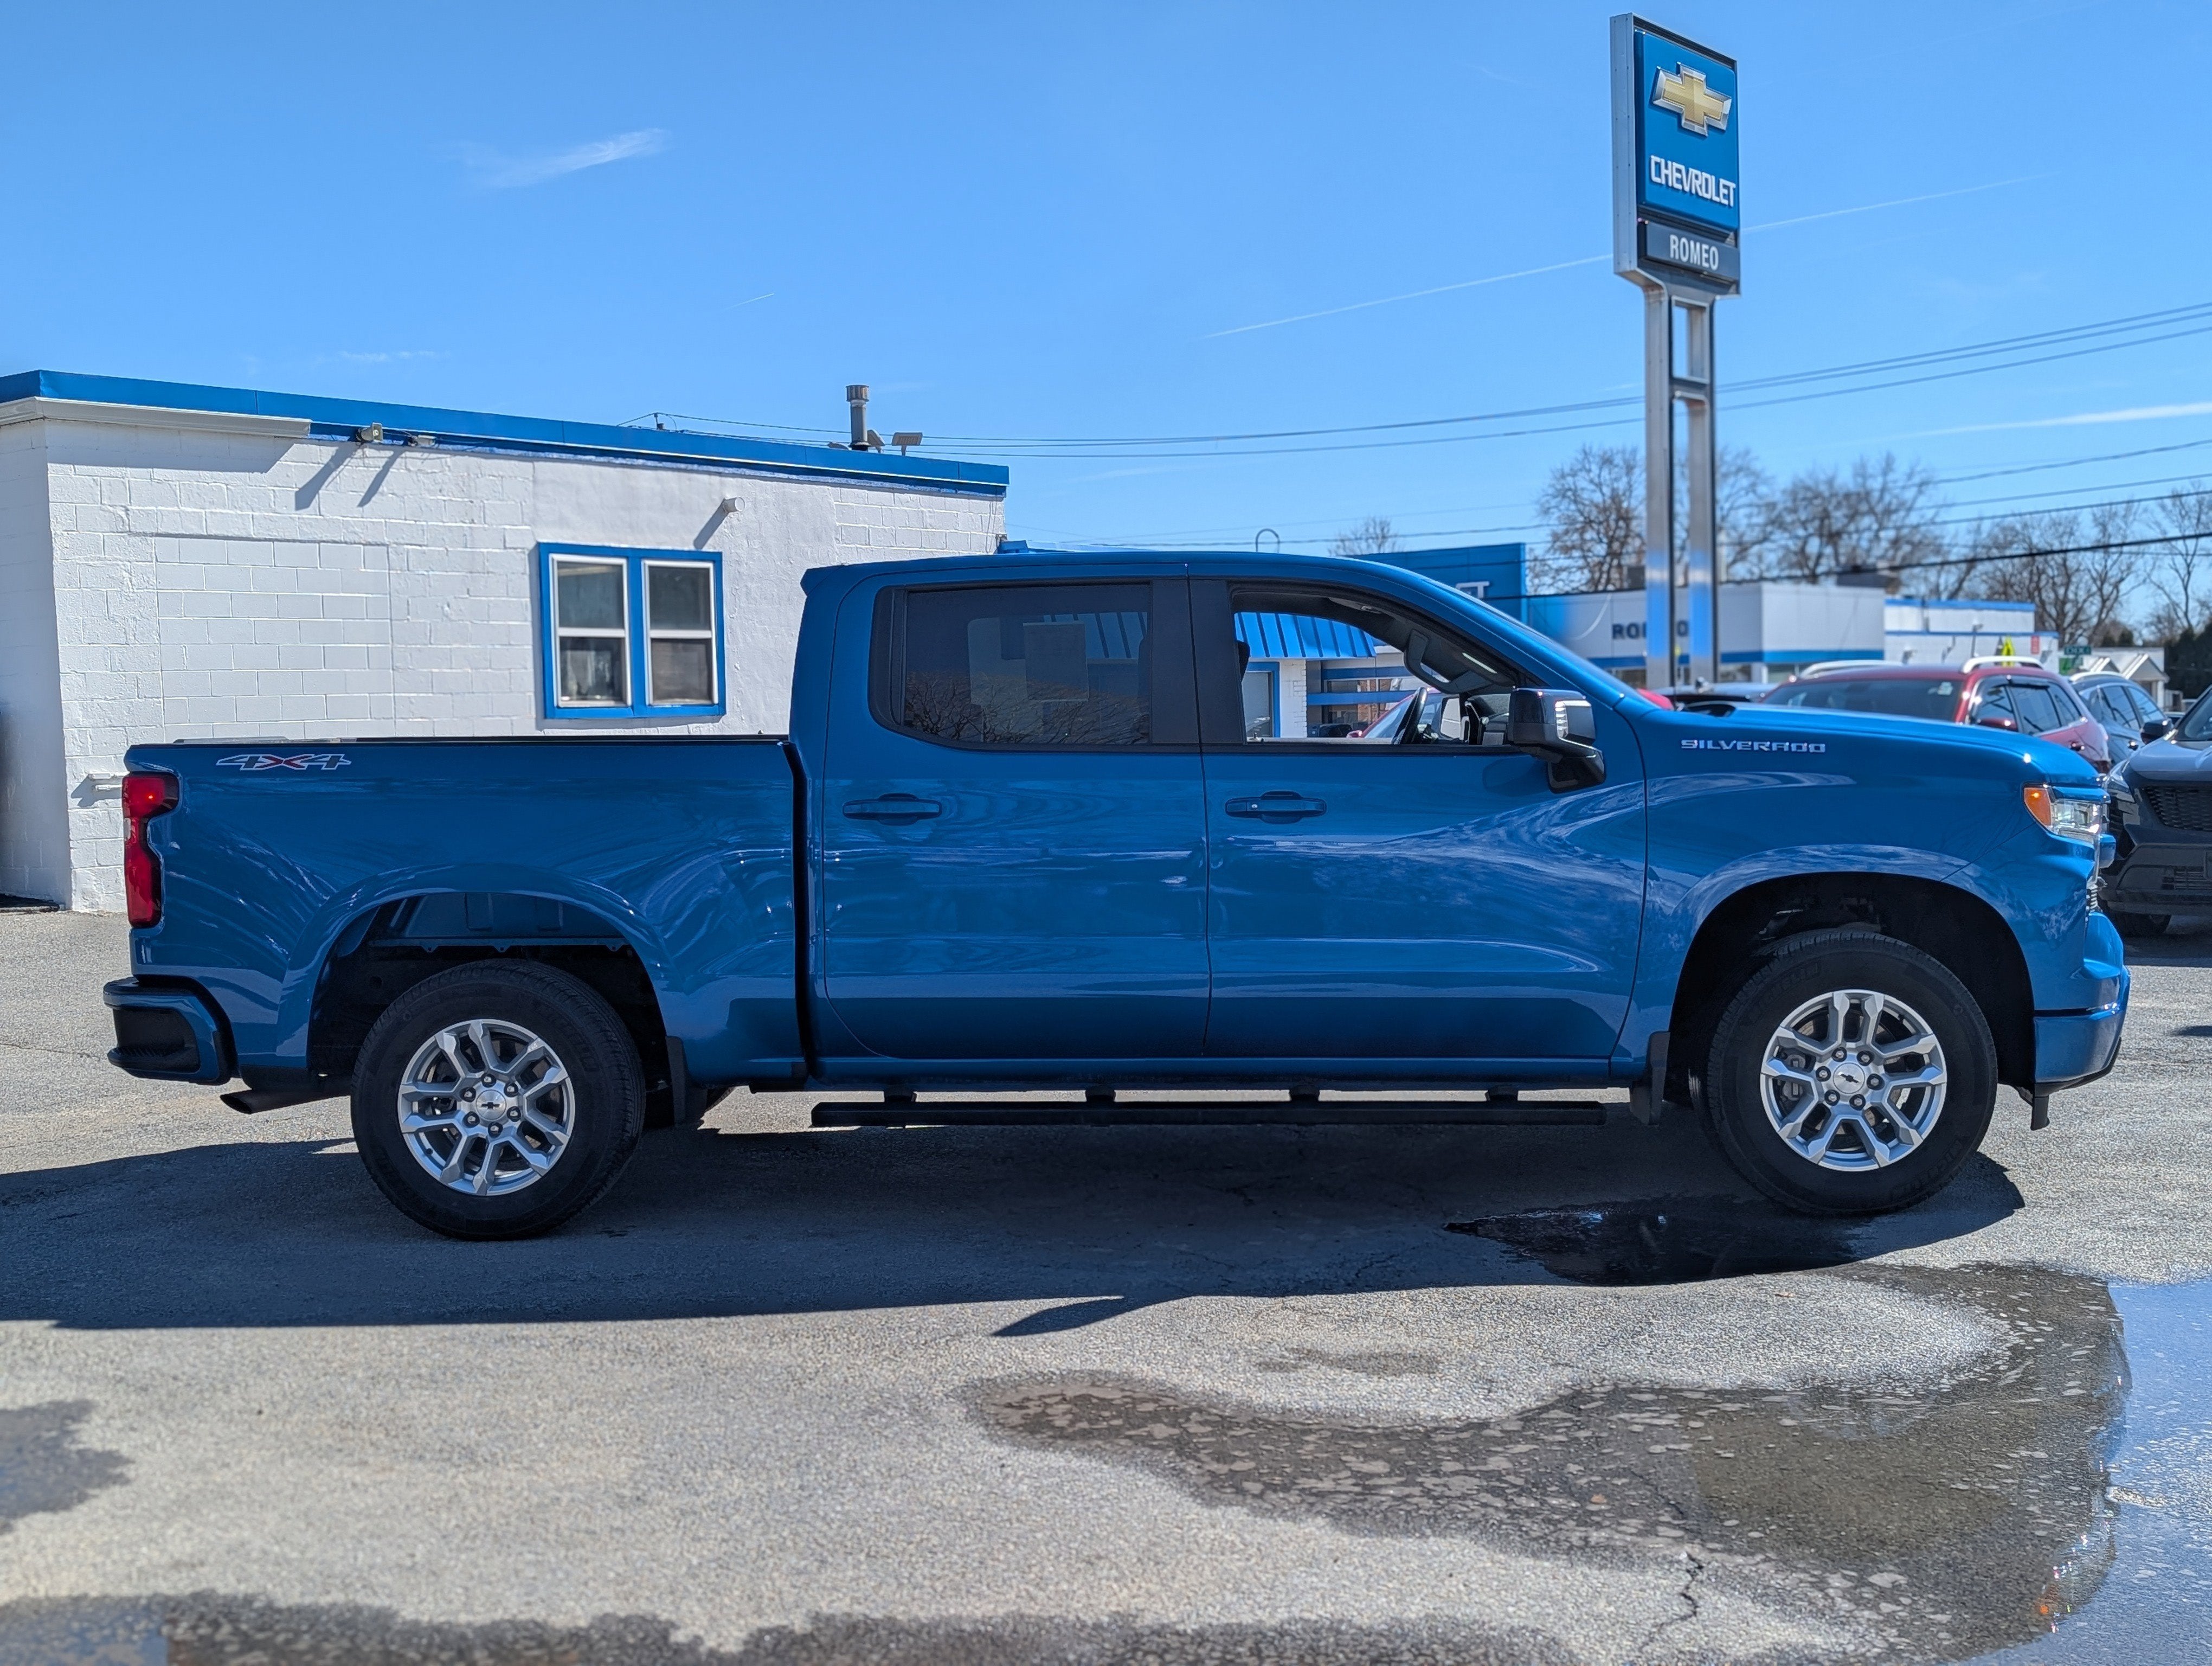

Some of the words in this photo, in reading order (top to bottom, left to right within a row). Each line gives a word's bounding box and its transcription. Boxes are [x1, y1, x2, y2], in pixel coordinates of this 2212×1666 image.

[1650, 155, 1736, 207] CHEVROLET
[1670, 234, 1718, 270] ROMEO
[1612, 620, 1689, 639] ROO
[1681, 739, 1825, 753] SILVERADO
